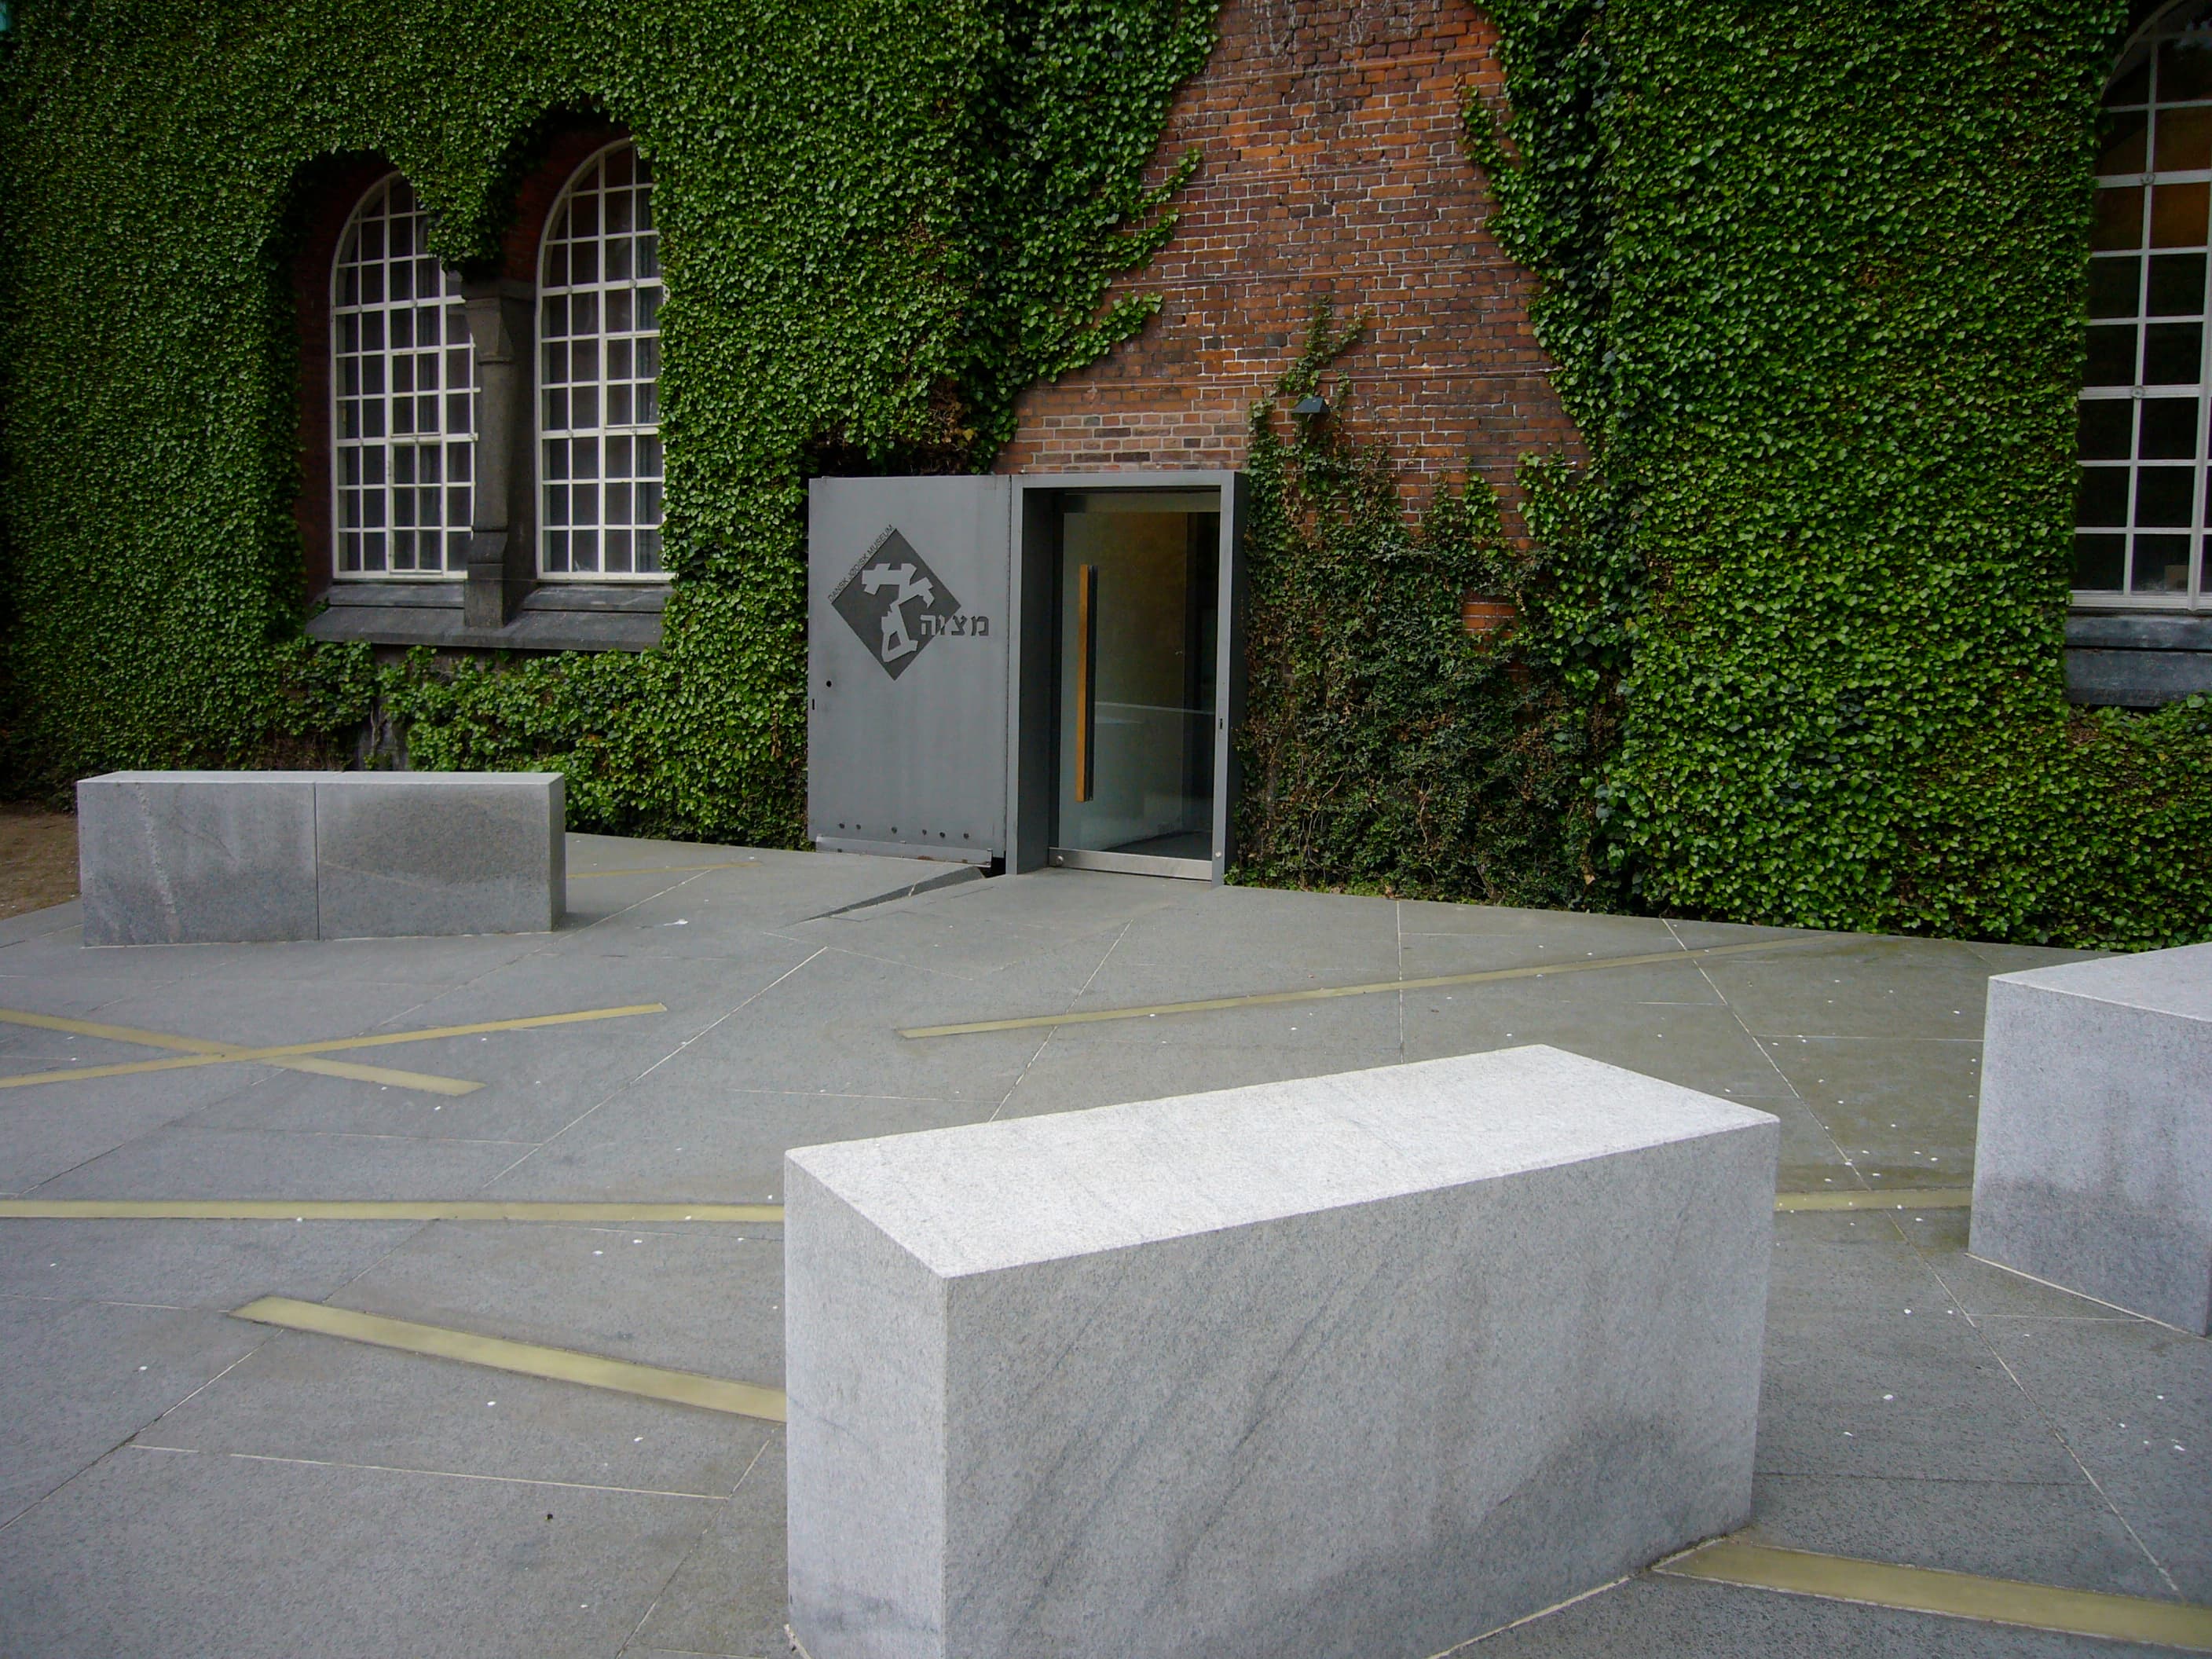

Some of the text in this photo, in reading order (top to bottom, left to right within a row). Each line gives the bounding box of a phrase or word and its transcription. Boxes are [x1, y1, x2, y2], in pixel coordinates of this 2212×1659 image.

[828, 524, 894, 602] DANSK JØDISK MUSEUM
[920, 614, 990, 636] מצוה
